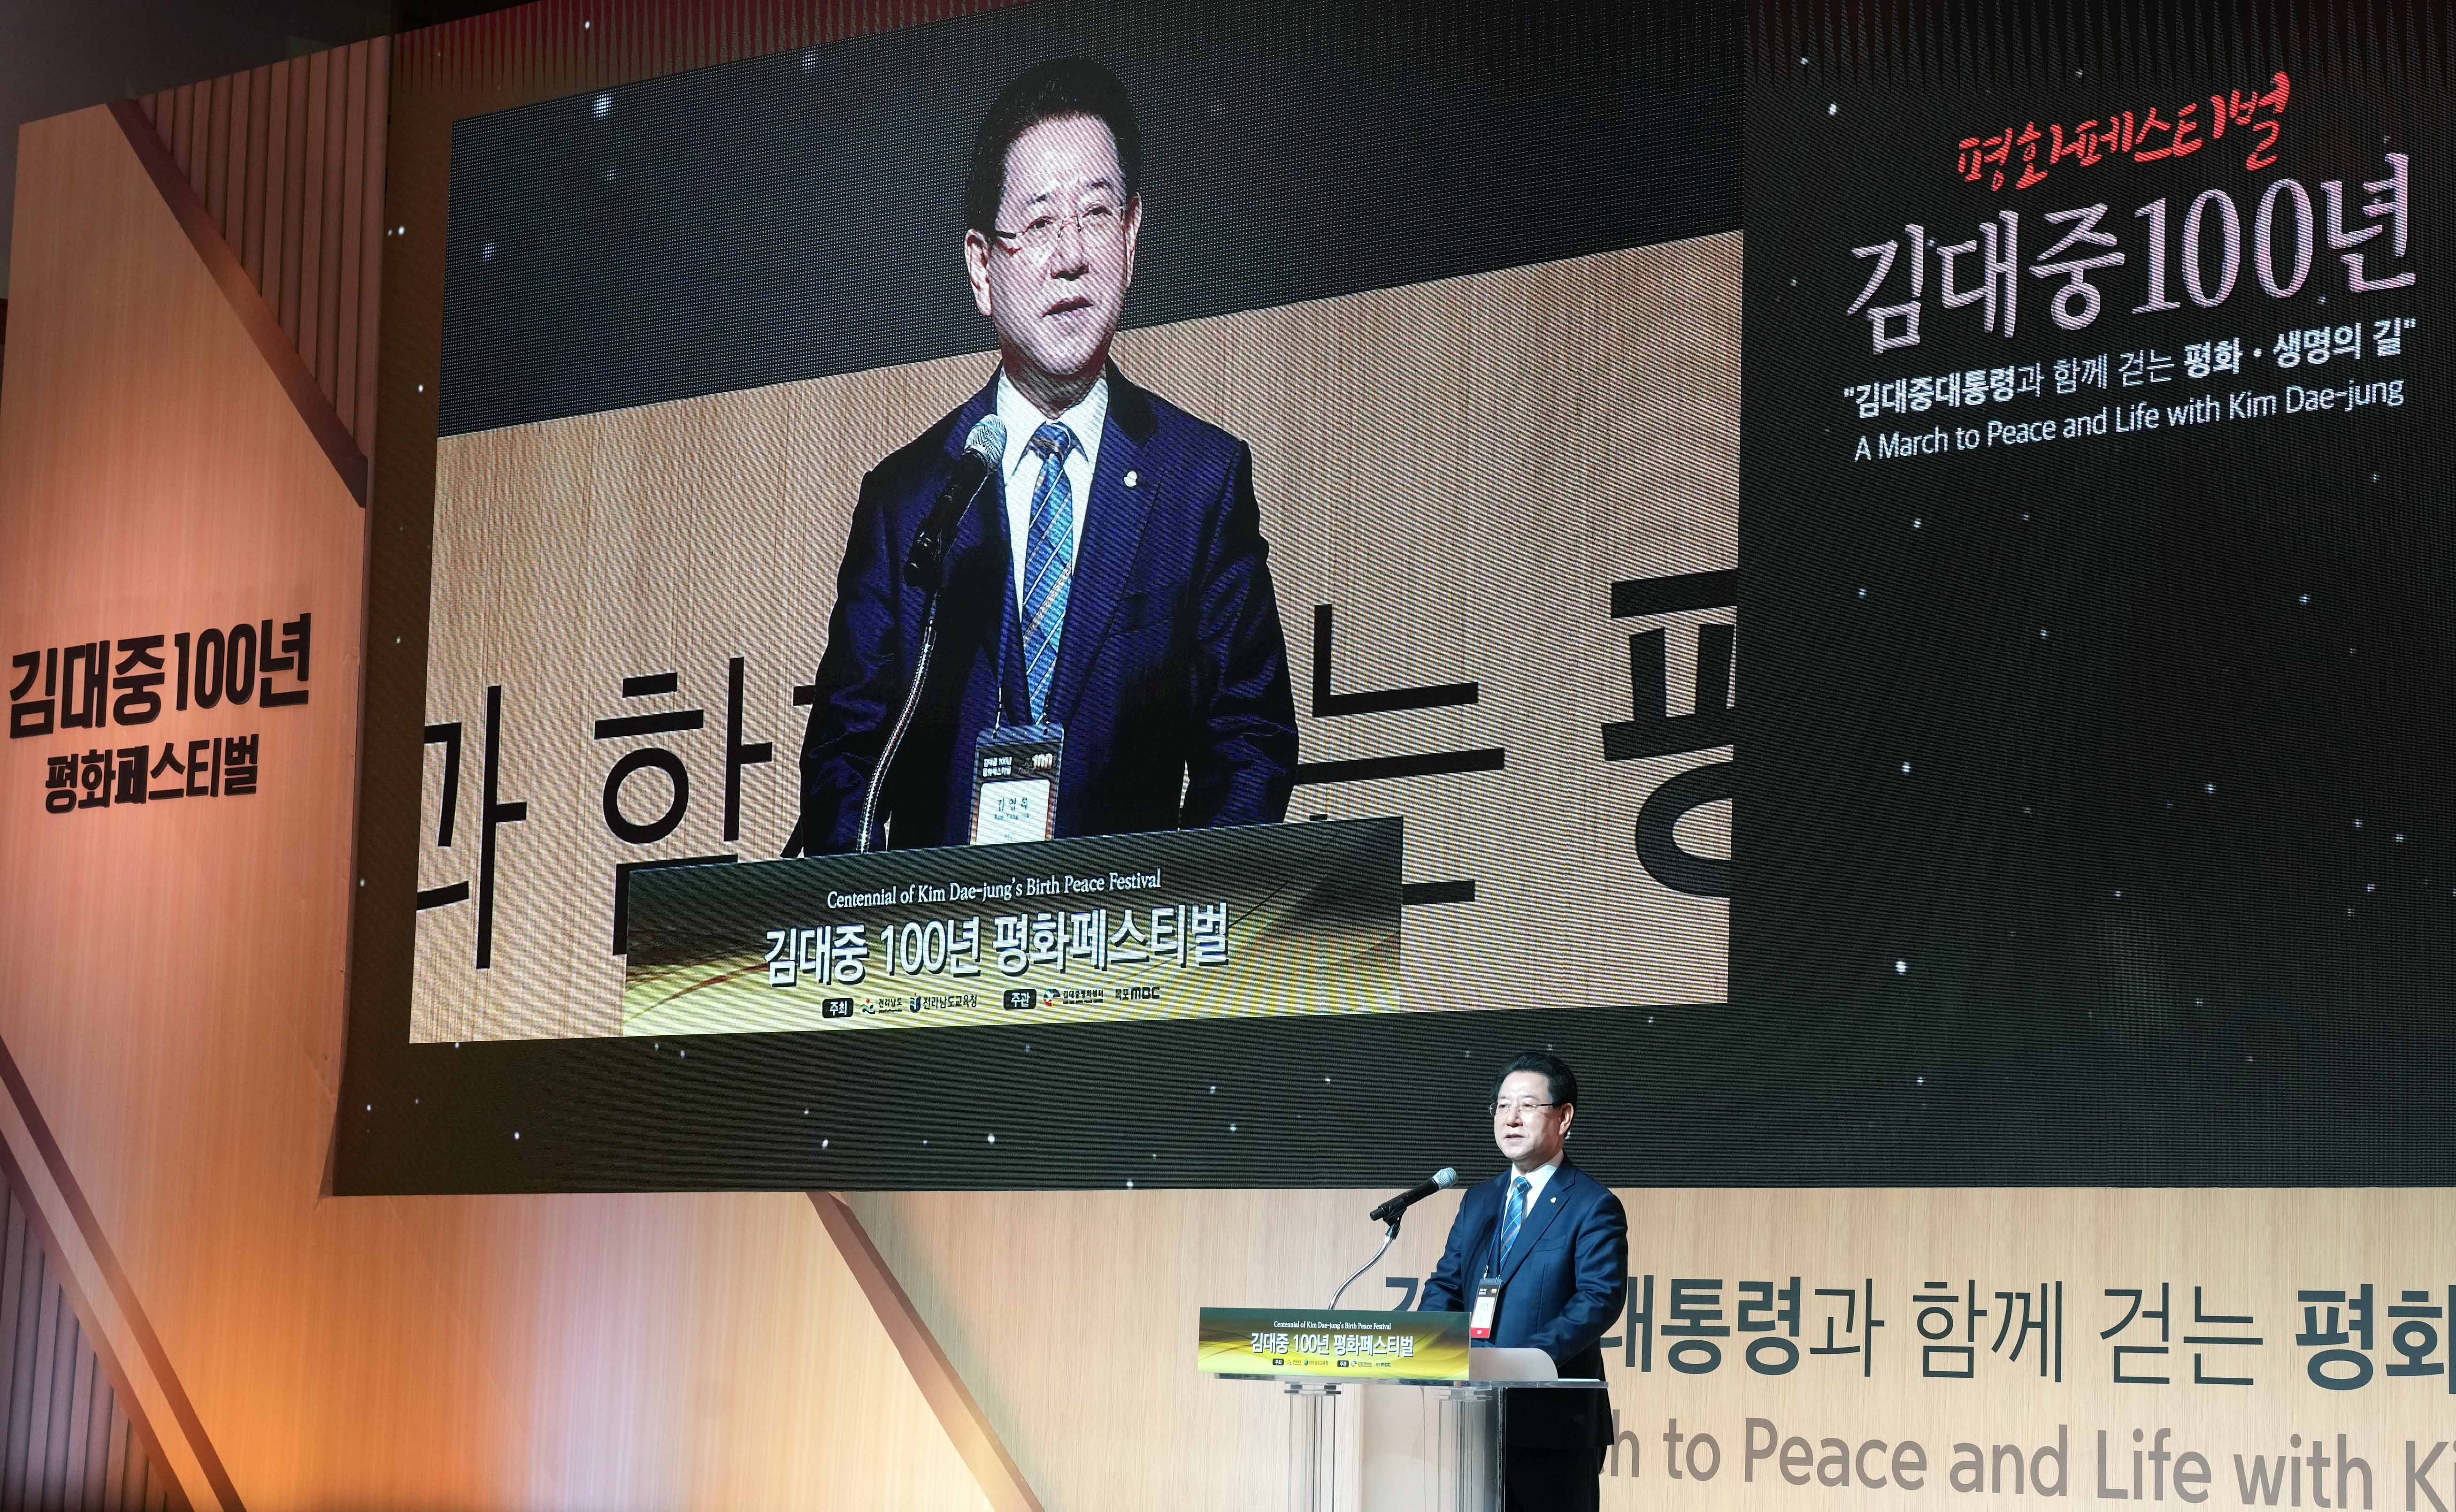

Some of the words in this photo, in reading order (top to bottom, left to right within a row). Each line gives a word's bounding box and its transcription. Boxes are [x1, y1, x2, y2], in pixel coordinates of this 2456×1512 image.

[1958, 71, 2289, 191] 평화페스티벌
[1844, 362, 2044, 419] "김대중대통령과
[2052, 353, 2108, 395] 함께
[2118, 348, 2175, 387] 걷는
[2183, 337, 2243, 379] 평화
[2272, 322, 2361, 368] 생명의
[2373, 316, 2417, 357] 길"
[1854, 435, 1871, 462] A
[1879, 426, 1948, 459] March
[1956, 428, 1980, 449] to
[1988, 420, 2056, 447] Peace
[2063, 406, 2107, 437] and
[2116, 402, 2159, 433] Life
[2167, 394, 2220, 427] with
[2230, 391, 2276, 420] Kim
[2286, 379, 2404, 413] Dae-jung
[45, 733, 259, 814] 평화페스티벌
[827, 886, 896, 909] Centennial
[901, 884, 914, 904] of
[918, 883, 945, 903] Kim
[950, 876, 1022, 901] Dae-jung's
[1026, 875, 1060, 896] Birth
[1065, 874, 1104, 893] Peace
[1109, 868, 1161, 889] Festival
[764, 924, 867, 987] 김대중
[881, 916, 981, 978] 100년
[991, 902, 1230, 975] 평화페스티벌
[1251, 1332, 1289, 1354] 김대중
[1293, 1334, 1329, 1355] 100년
[1333, 1335, 1414, 1358] 평화페스티벌
[1912, 1279, 2063, 1382] 함께
[2099, 1282, 2263, 1385] 걷는
[2295, 1283, 2456, 1395] 평화
[1663, 1418, 1720, 1481] to
[1744, 1417, 1925, 1489] Peace
[1949, 1424, 2068, 1498] and
[2097, 1428, 2213, 1504] Life
[2233, 1434, 2373, 1510] with
[2406, 1440, 2456, 1512] K
